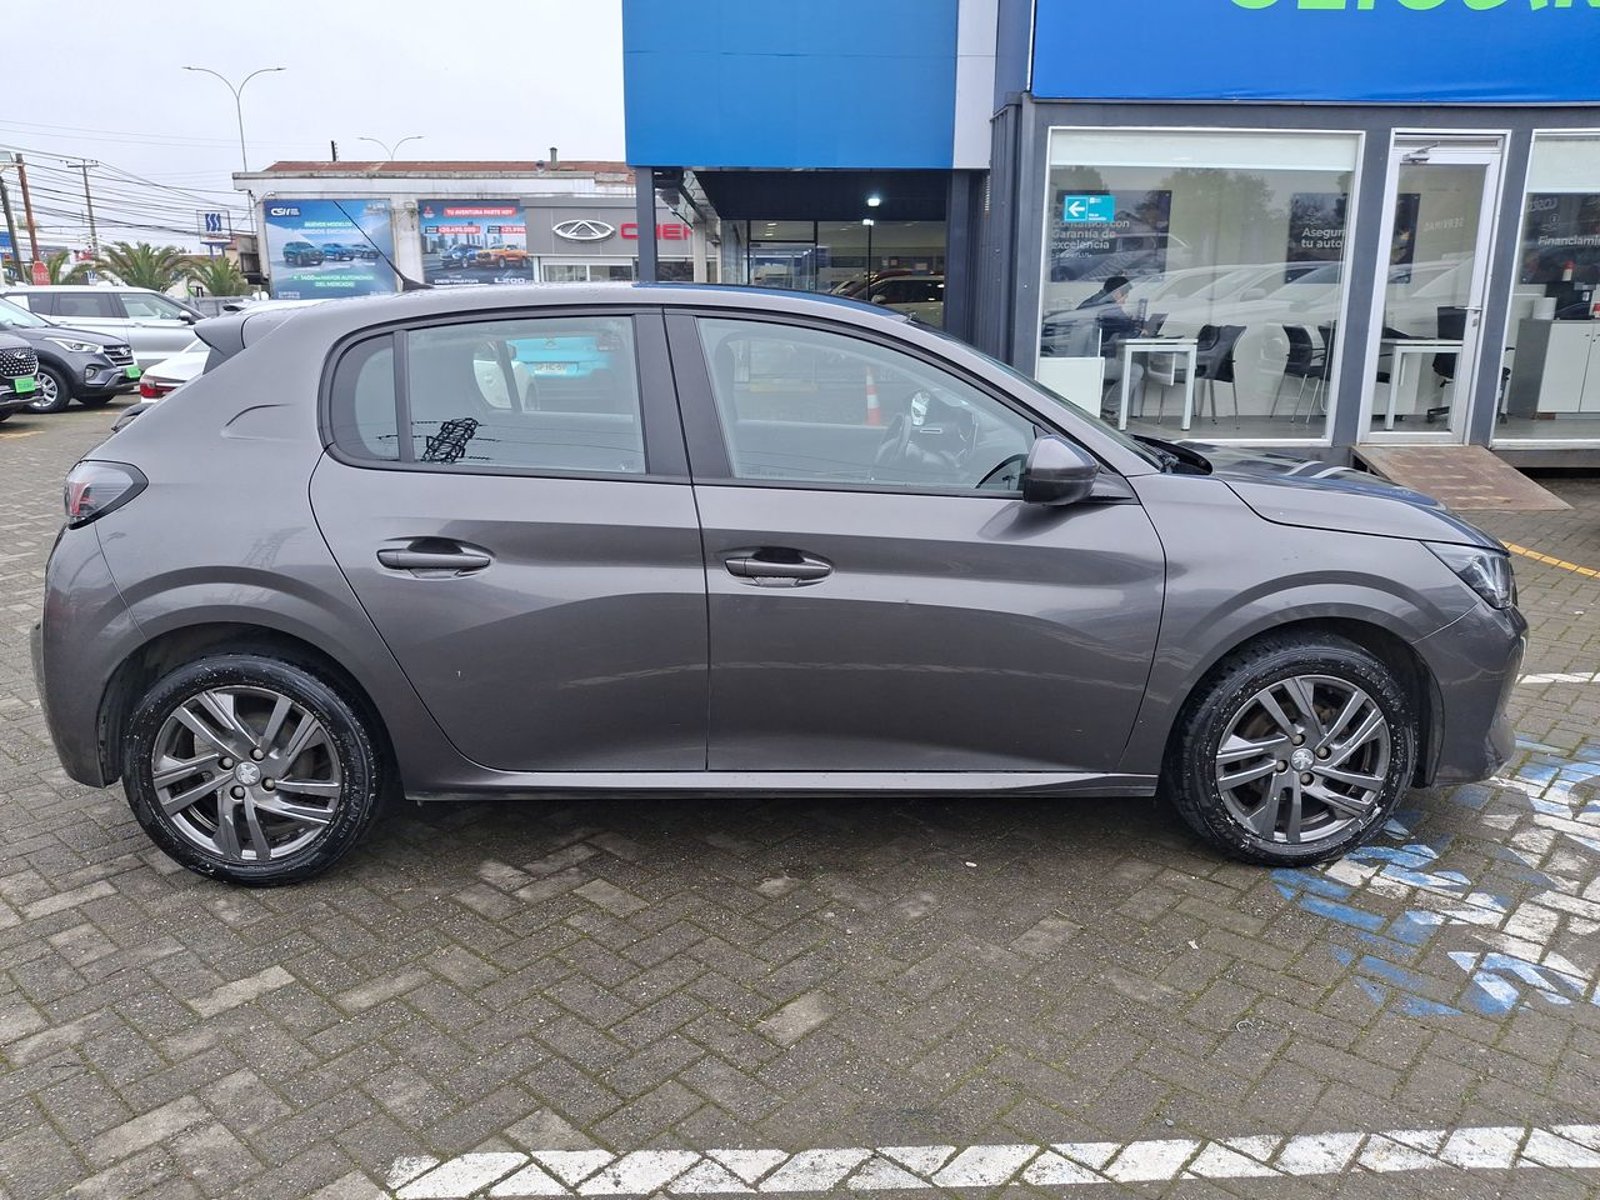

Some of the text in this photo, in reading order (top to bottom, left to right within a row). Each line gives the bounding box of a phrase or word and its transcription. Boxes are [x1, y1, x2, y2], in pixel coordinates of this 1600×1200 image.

[1101, 228, 1117, 239] de
[1051, 239, 1110, 250] excelencia
[1301, 239, 1343, 248] tu auto
